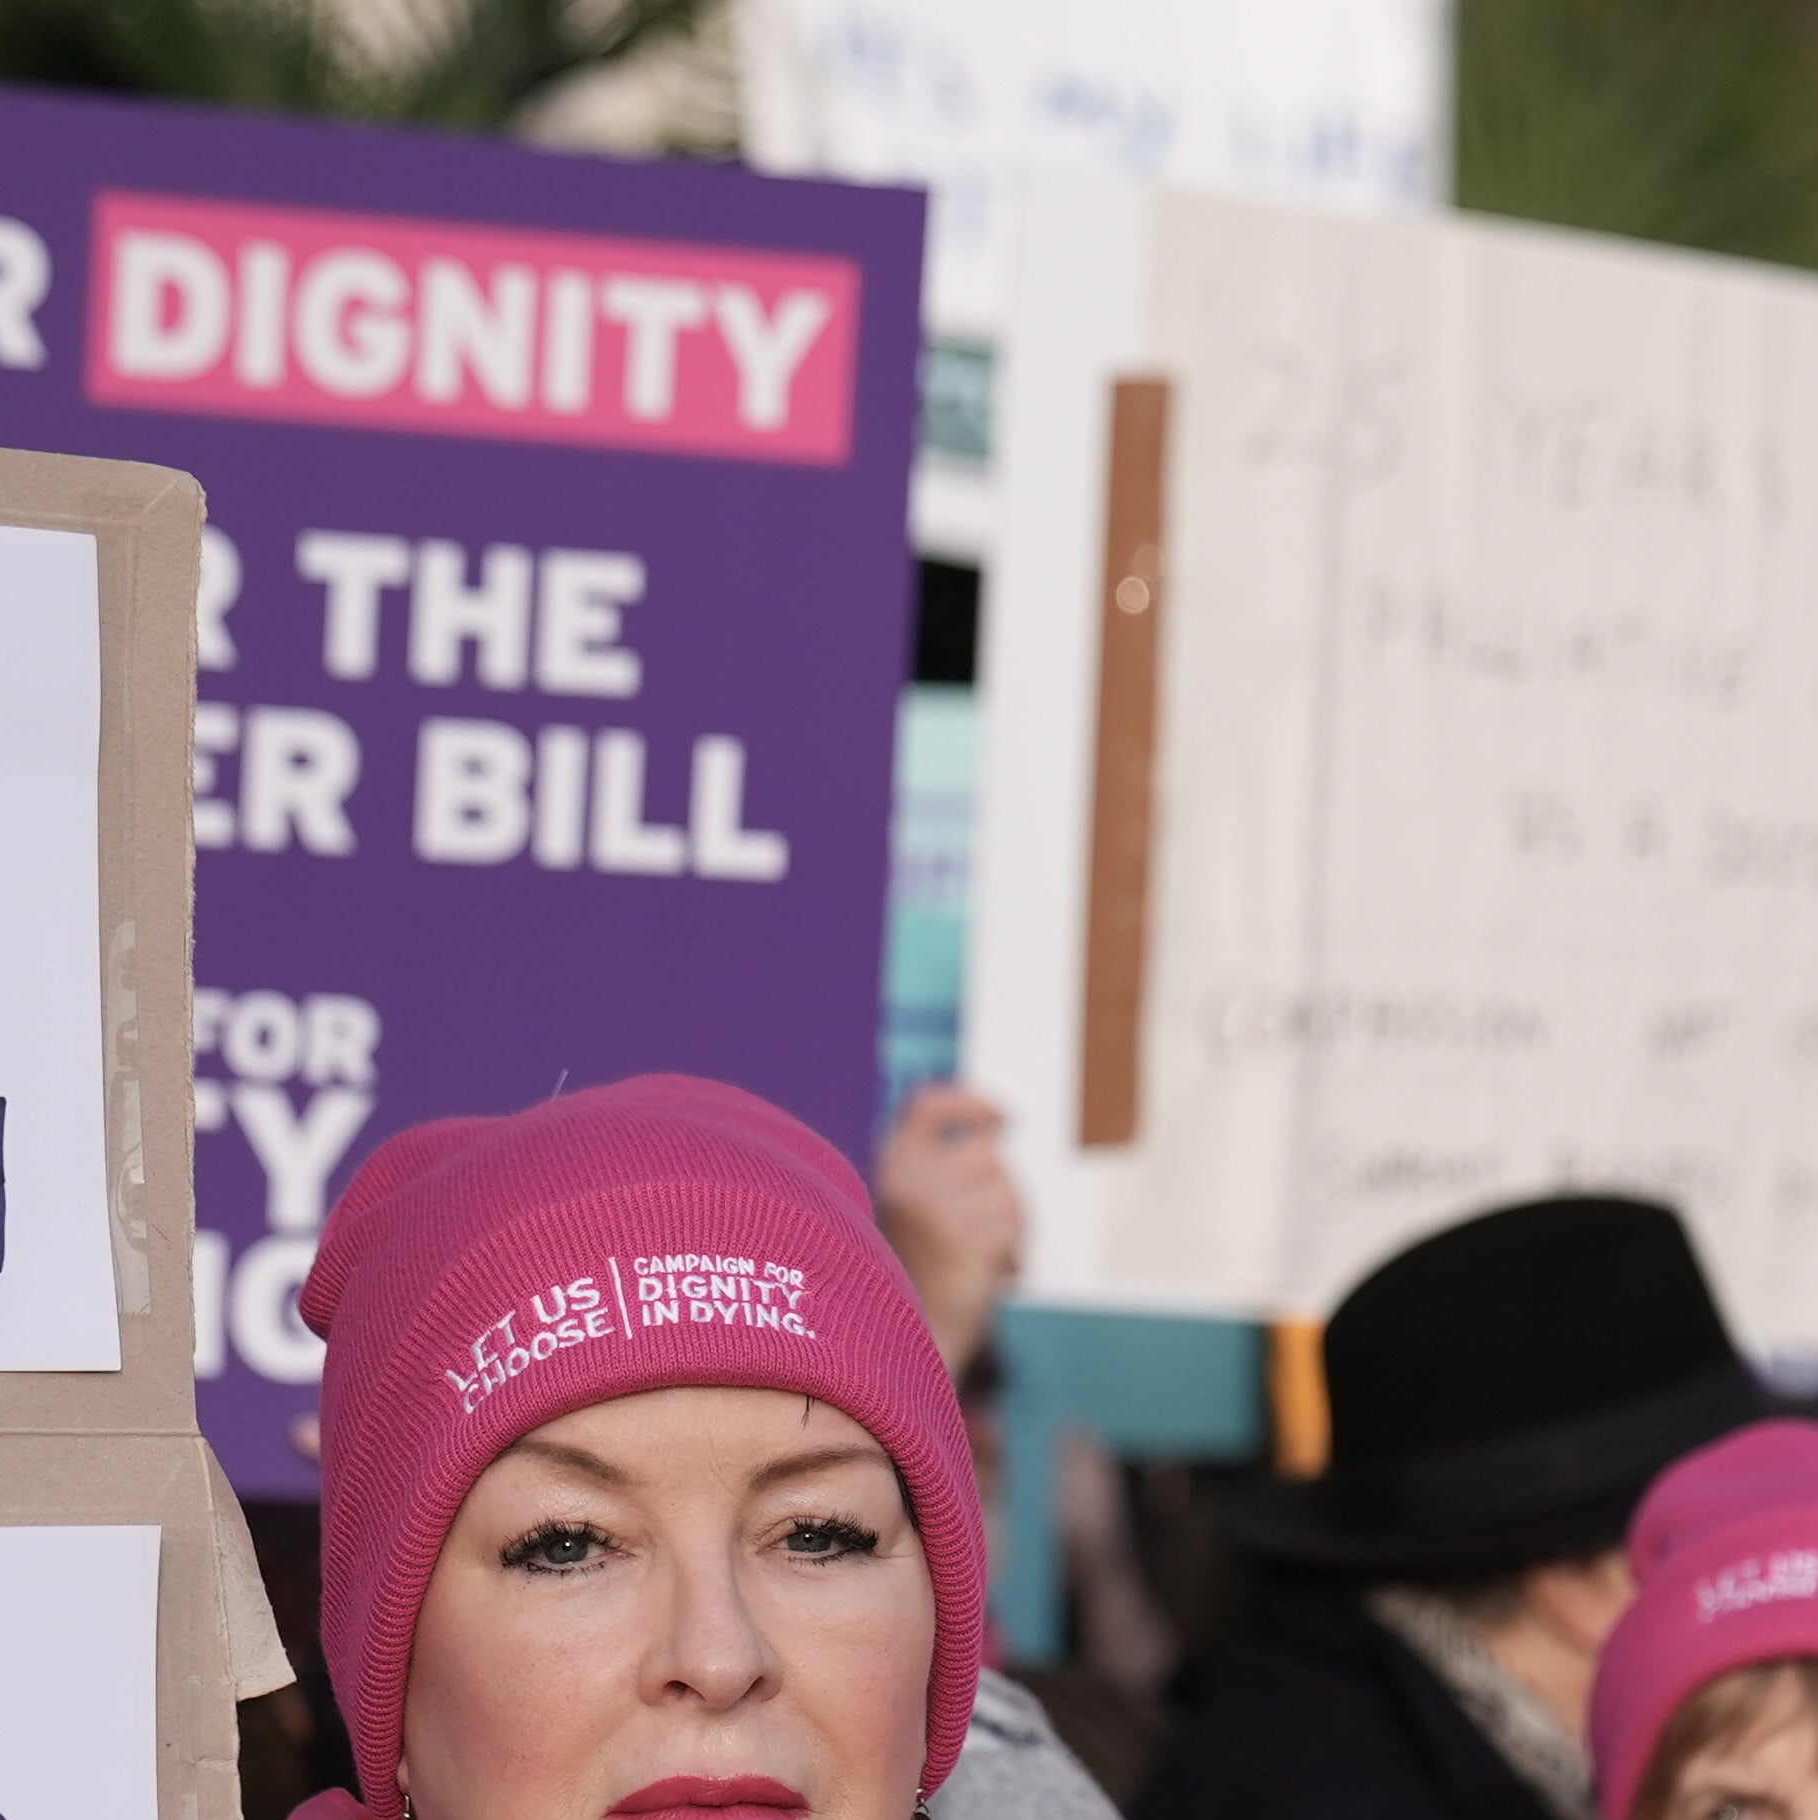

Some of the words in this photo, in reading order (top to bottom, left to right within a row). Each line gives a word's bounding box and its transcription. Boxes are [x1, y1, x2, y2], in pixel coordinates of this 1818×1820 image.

[107, 226, 833, 432] DIGNITY
[294, 526, 649, 702] THE
[409, 714, 789, 884] BILL
[633, 1252, 756, 1277] CAMPAIGN
[763, 1260, 805, 1290] FOR
[638, 1273, 811, 1310] DIGNITY
[642, 1301, 680, 1327] IN
[689, 1299, 818, 1340] DYING.
[445, 1308, 517, 1393] LET
[530, 1276, 601, 1323] US
[462, 1306, 616, 1415] CHOOSE
